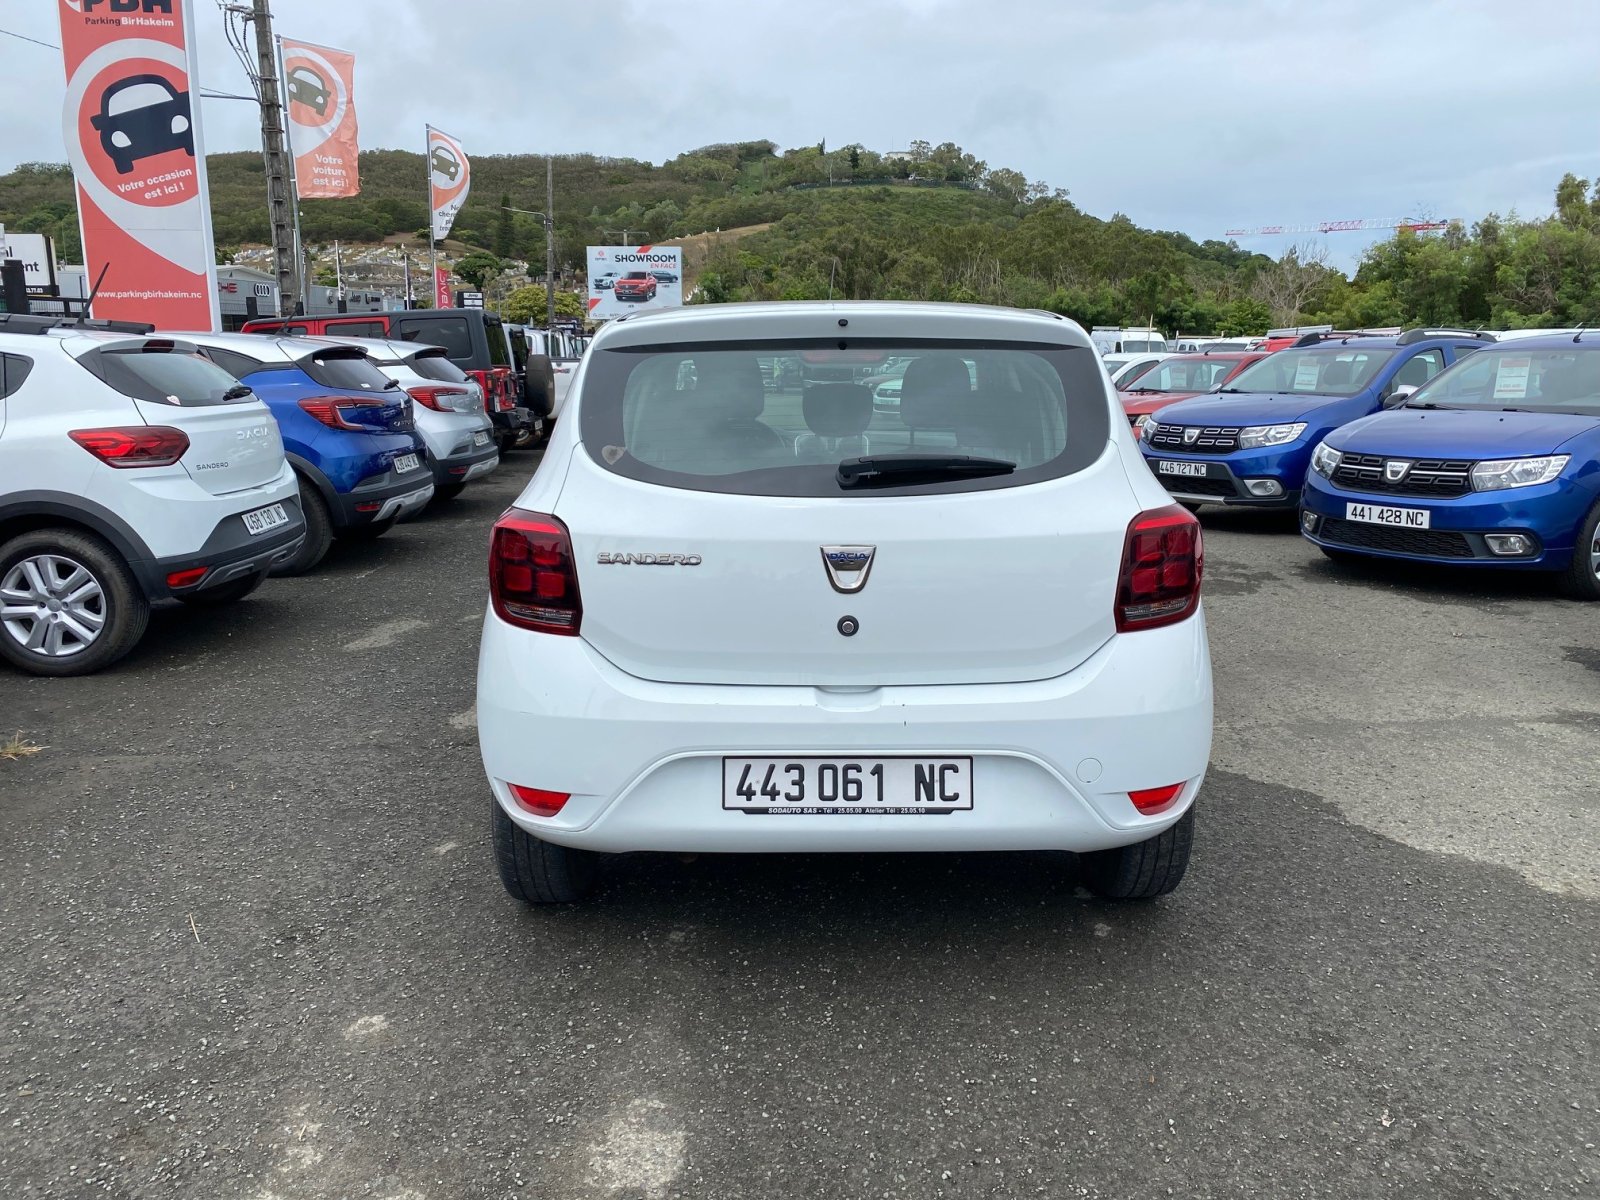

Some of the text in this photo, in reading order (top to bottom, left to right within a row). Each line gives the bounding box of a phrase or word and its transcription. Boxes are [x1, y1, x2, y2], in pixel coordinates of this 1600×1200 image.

[314, 153, 344, 165] Votre
[117, 168, 192, 193] Votre occasion
[312, 177, 330, 186] est
[144, 188, 162, 200] est
[614, 254, 677, 263] SHOWROOM
[96, 290, 202, 300] www.parkingbirhakeim.nc
[196, 461, 229, 471] SANDERO
[1160, 462, 1206, 476] 446 727 NC
[1351, 505, 1424, 526] 441 428 NC
[597, 551, 702, 566] SANDERO
[829, 552, 867, 560] DACIA
[736, 763, 960, 802] 443 061 NC
